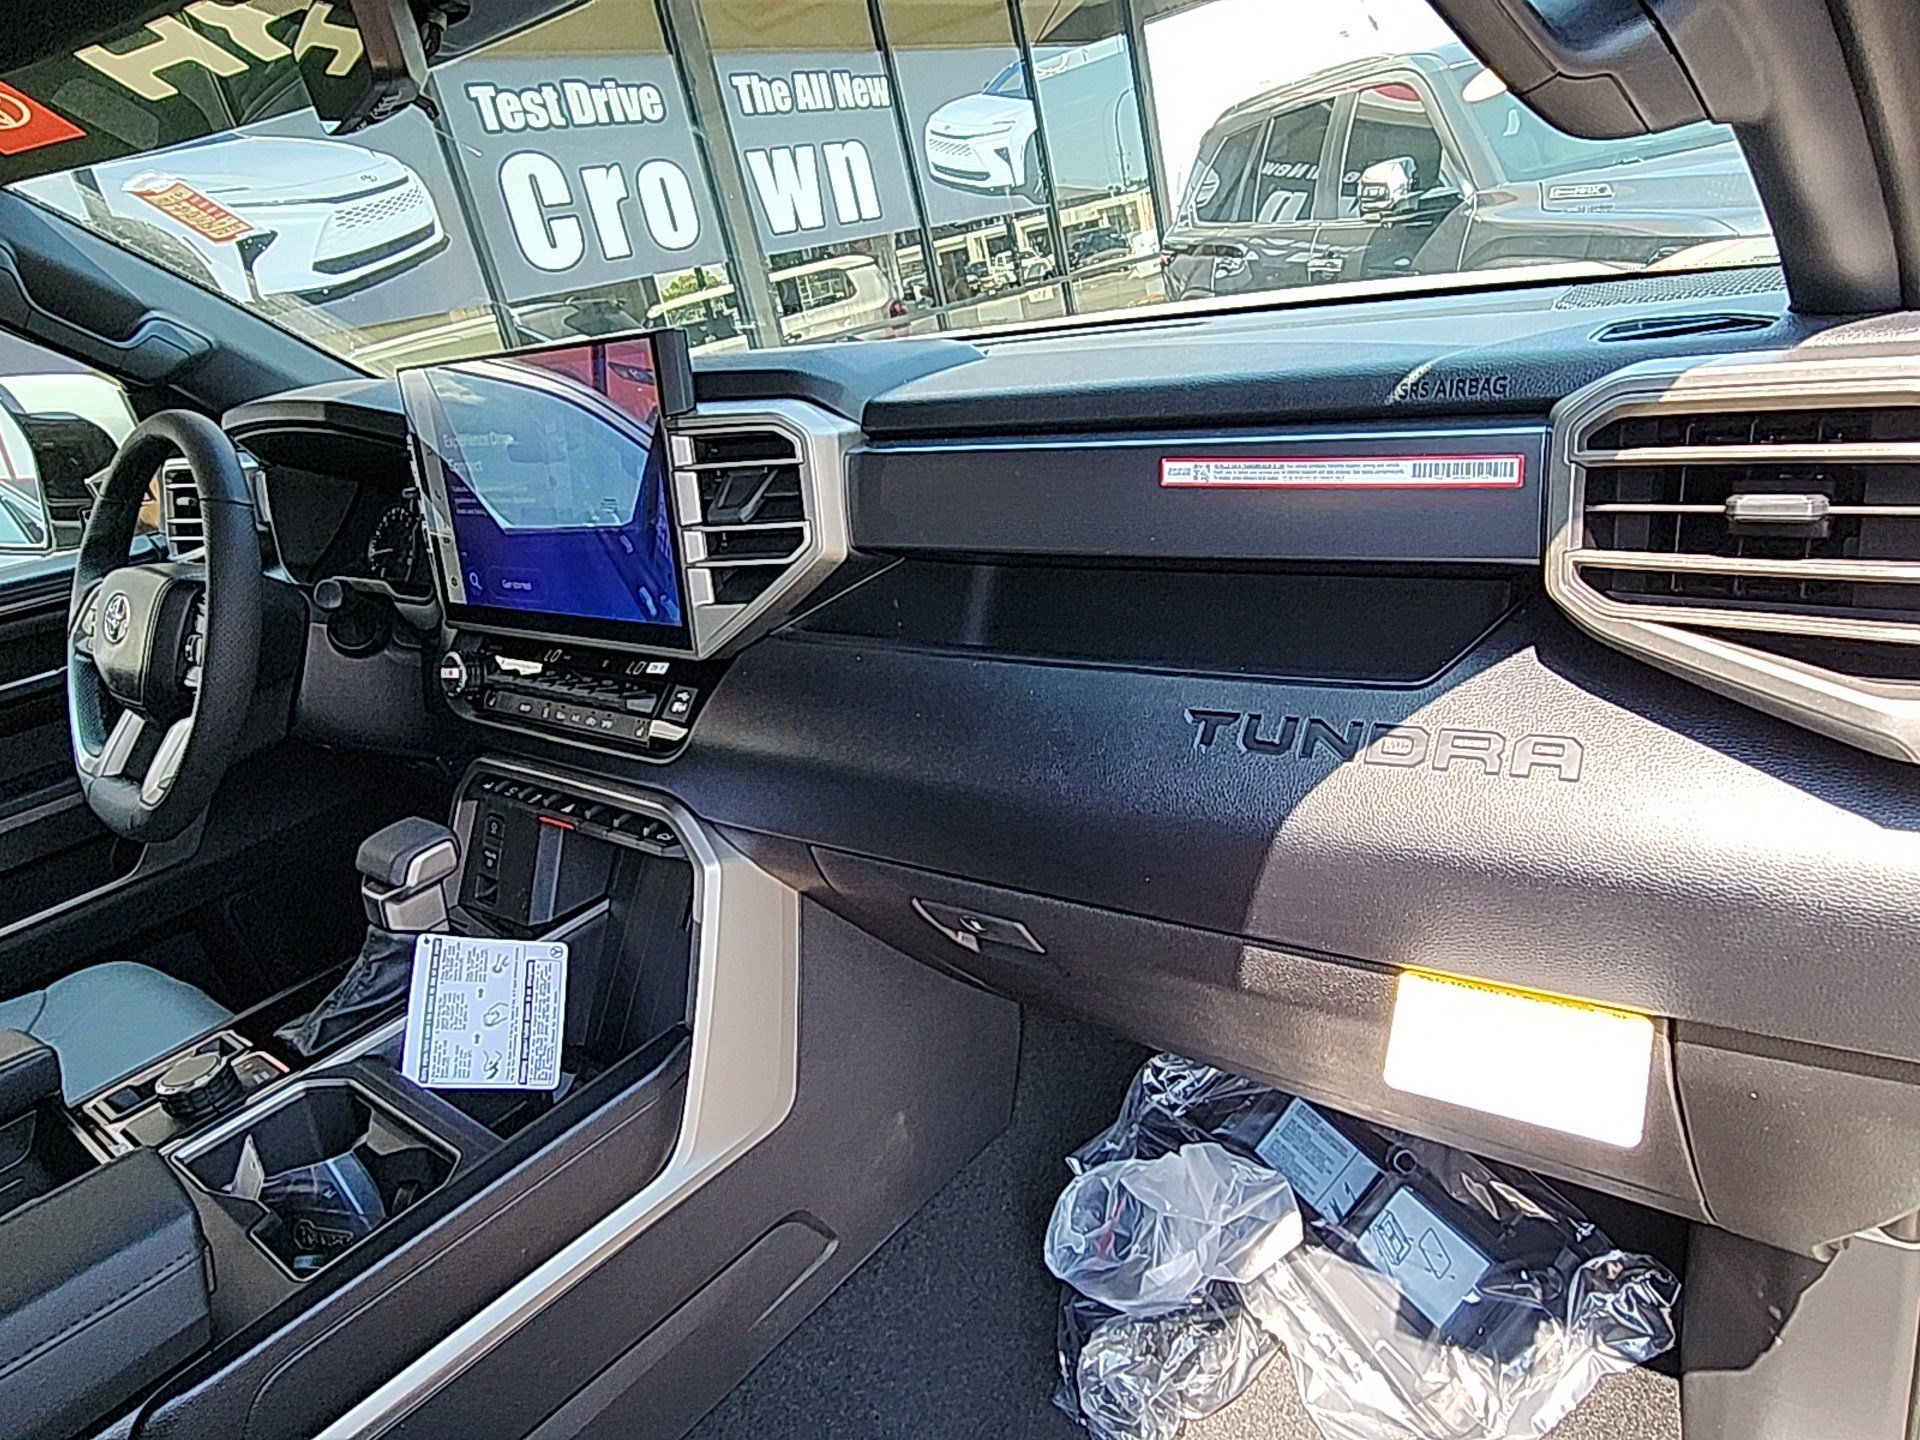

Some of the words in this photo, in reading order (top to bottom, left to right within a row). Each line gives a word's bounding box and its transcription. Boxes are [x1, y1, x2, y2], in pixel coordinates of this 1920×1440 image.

[465, 83, 568, 132] Test
[561, 79, 666, 127] Drive
[729, 73, 793, 116] The
[792, 71, 835, 113] All
[831, 70, 892, 109] New
[1397, 381, 1429, 401] SRS
[1433, 376, 1508, 399] AIRBAG
[1185, 708, 1583, 782] TUNDRA
